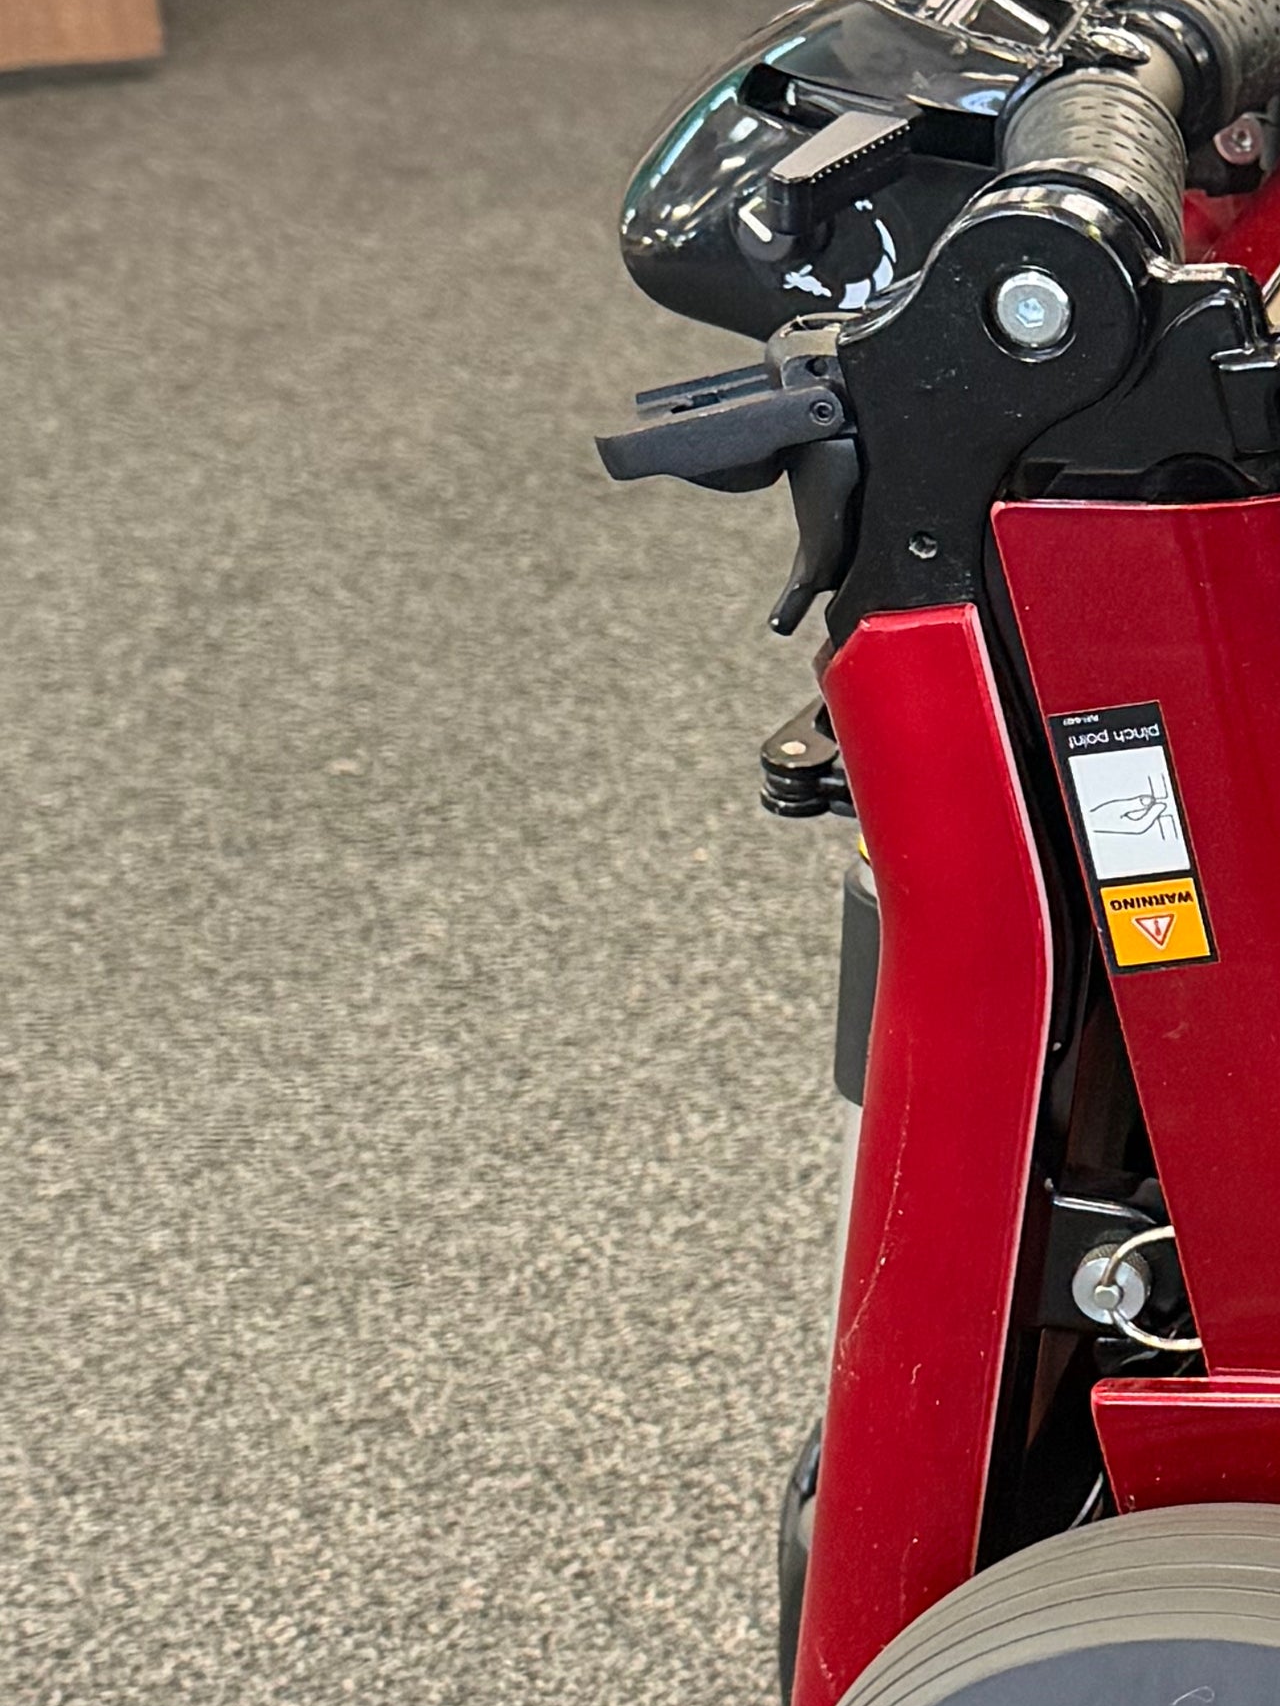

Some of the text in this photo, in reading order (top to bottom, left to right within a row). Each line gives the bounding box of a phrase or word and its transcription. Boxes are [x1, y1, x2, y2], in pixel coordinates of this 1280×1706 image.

[1068, 723, 1160, 749] pinch point
[1110, 891, 1194, 911] WARNING
